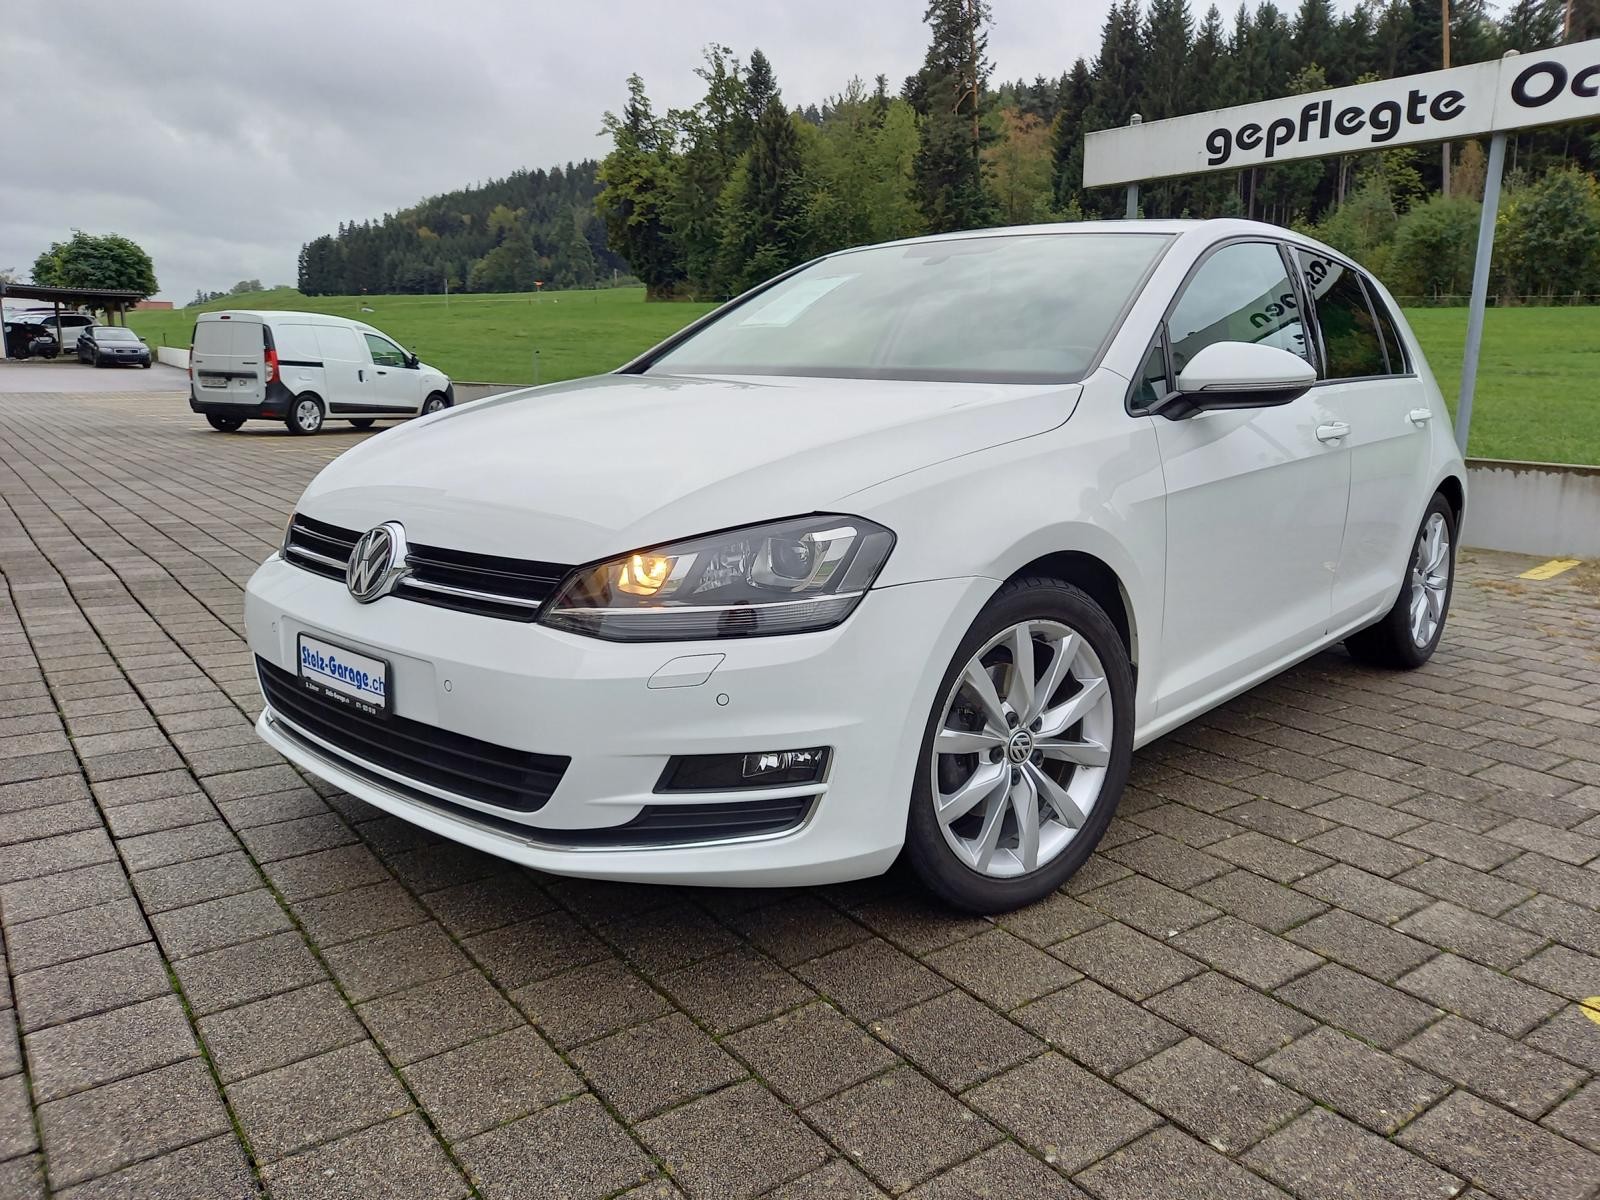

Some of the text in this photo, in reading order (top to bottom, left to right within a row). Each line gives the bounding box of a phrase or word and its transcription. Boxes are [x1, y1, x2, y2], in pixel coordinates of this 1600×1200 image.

[1205, 89, 1466, 166] gepflegte
[348, 528, 392, 600] VW
[1010, 731, 1032, 763] VW
